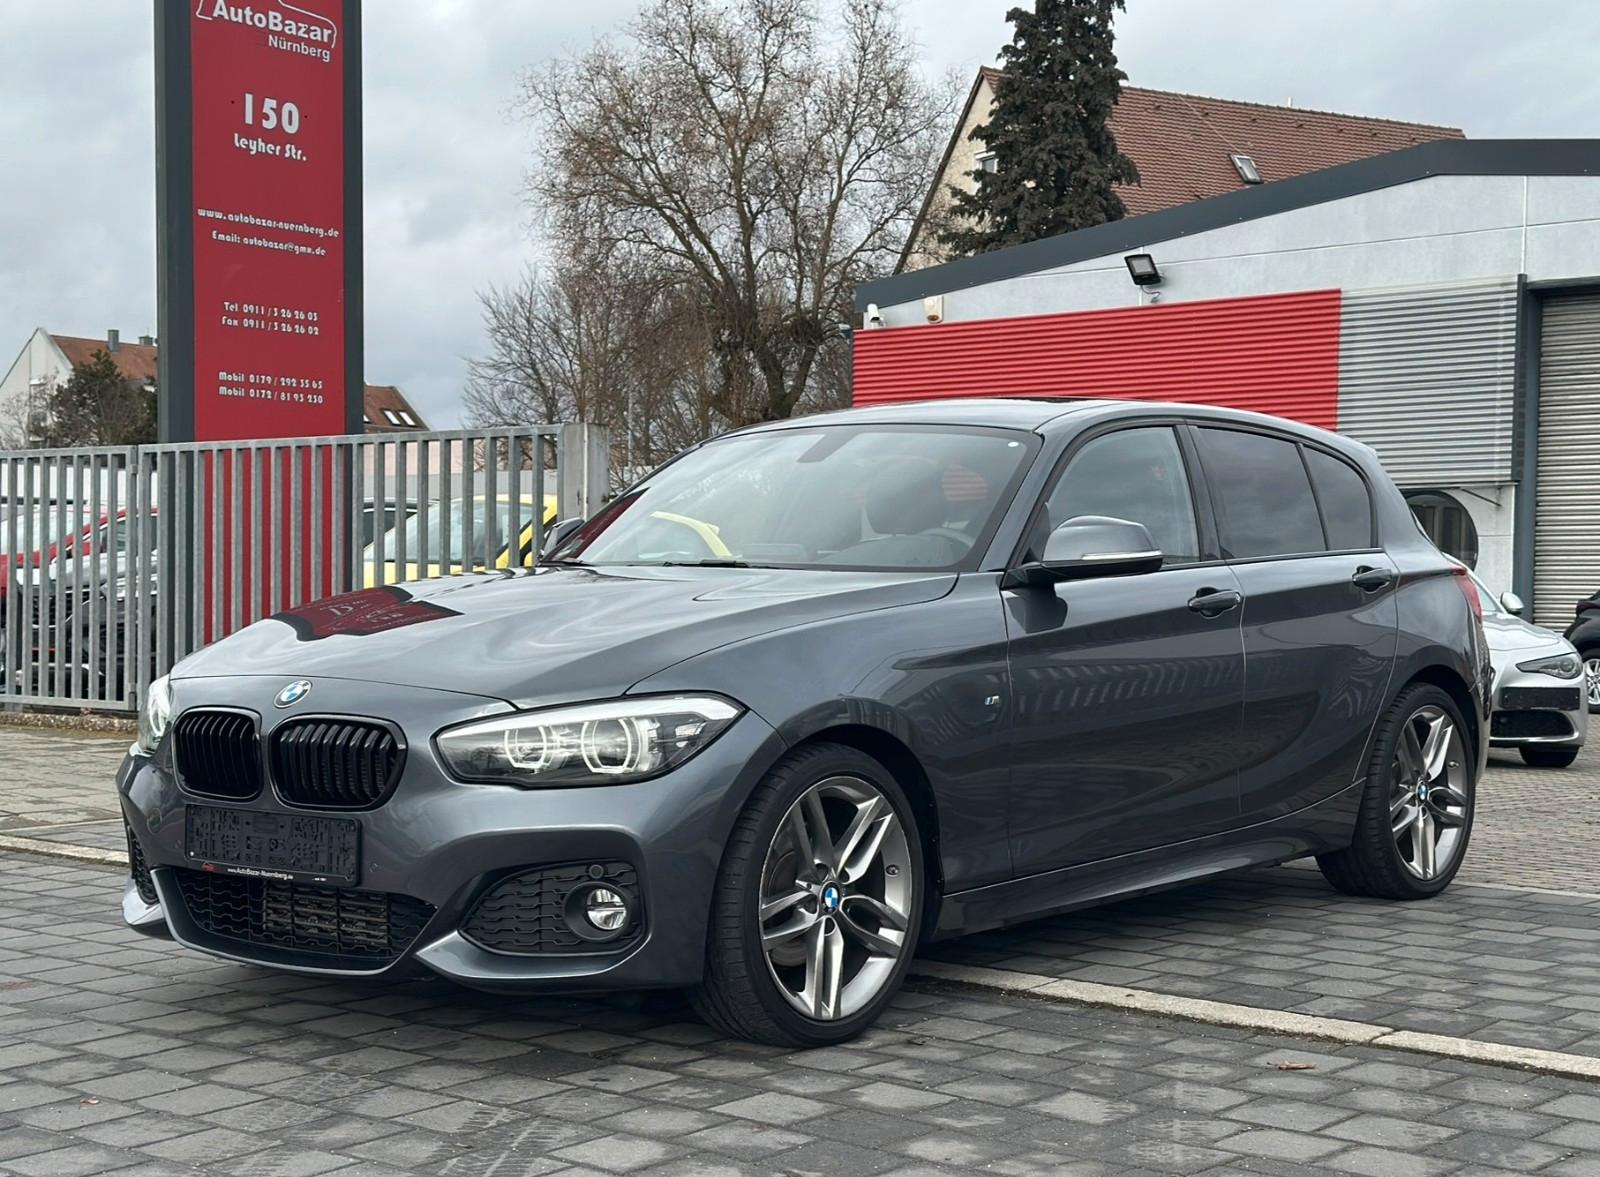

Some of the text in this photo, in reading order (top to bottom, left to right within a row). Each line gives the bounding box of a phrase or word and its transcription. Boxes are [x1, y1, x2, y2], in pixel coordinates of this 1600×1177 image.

[212, 0, 332, 43] AutoBazar
[268, 34, 331, 63] Nürnberg
[285, 144, 307, 161] Str.
[197, 208, 340, 238] www.autobazar-nuernberg.de
[211, 230, 326, 256] Email: autobazar@gmx.de
[224, 302, 239, 312] Tel
[243, 304, 265, 315] 0911
[273, 308, 279, 316] 3
[280, 309, 292, 318] 26
[294, 310, 306, 320] 26
[307, 312, 318, 321] 03
[222, 316, 239, 326] Fax
[243, 318, 265, 329] 0911
[273, 322, 279, 331] 3
[280, 323, 293, 332] 26
[294, 325, 306, 334] 26
[307, 327, 319, 335] 02
[218, 372, 245, 382] Mobil
[249, 374, 272, 384] 0179
[280, 377, 297, 387] 292
[218, 386, 245, 396] Mobil
[249, 388, 272, 399] 0172
